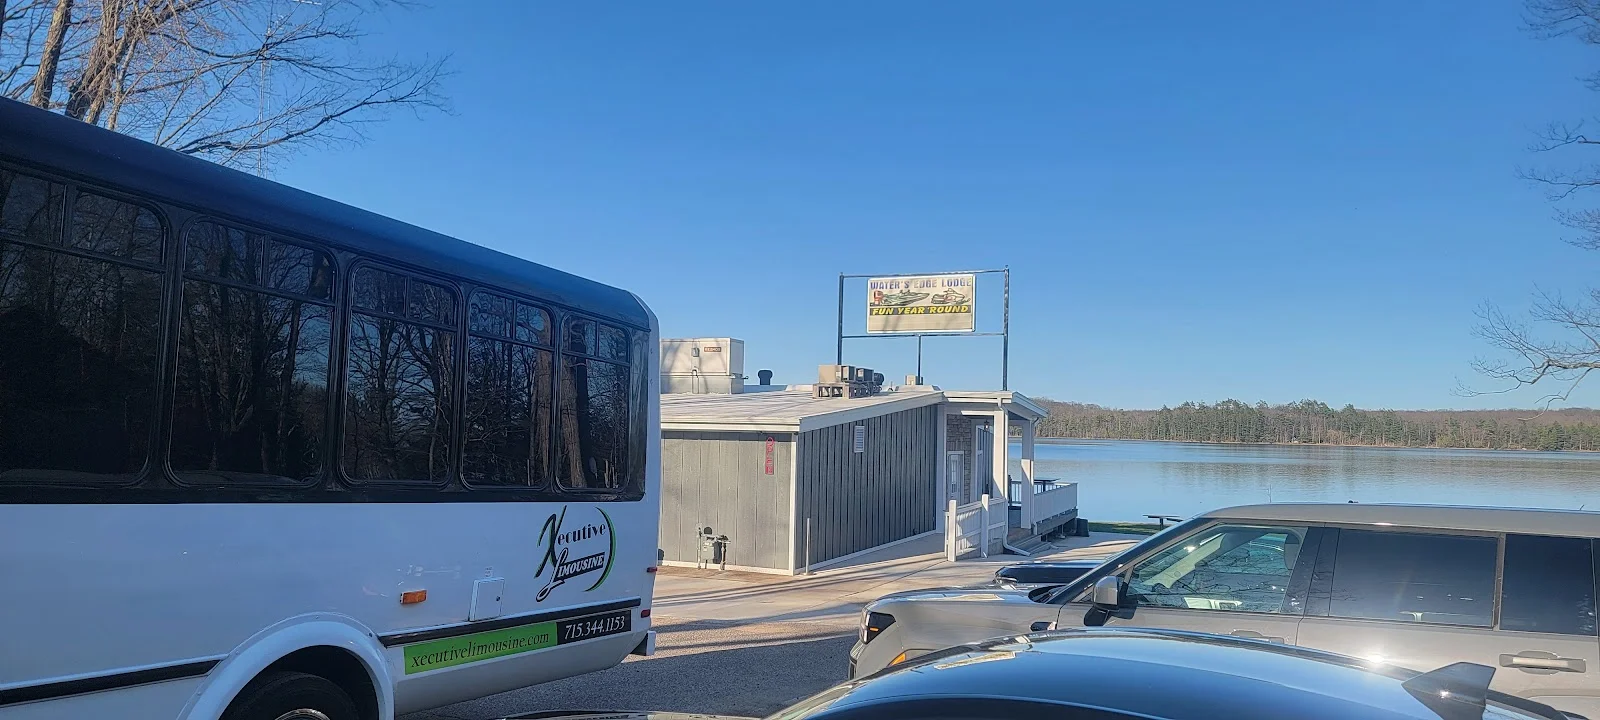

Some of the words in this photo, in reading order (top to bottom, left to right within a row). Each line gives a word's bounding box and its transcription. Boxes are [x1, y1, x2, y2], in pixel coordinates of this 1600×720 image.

[870, 281, 910, 290] WATER'S
[914, 278, 937, 288] EDGE
[941, 277, 972, 288] LODGE
[872, 307, 893, 316] FUN
[898, 306, 925, 315] YEAR
[534, 504, 606, 579] Xecutive
[564, 615, 625, 640] 715.344.1153
[411, 631, 549, 668] xecutivelimousine.com
